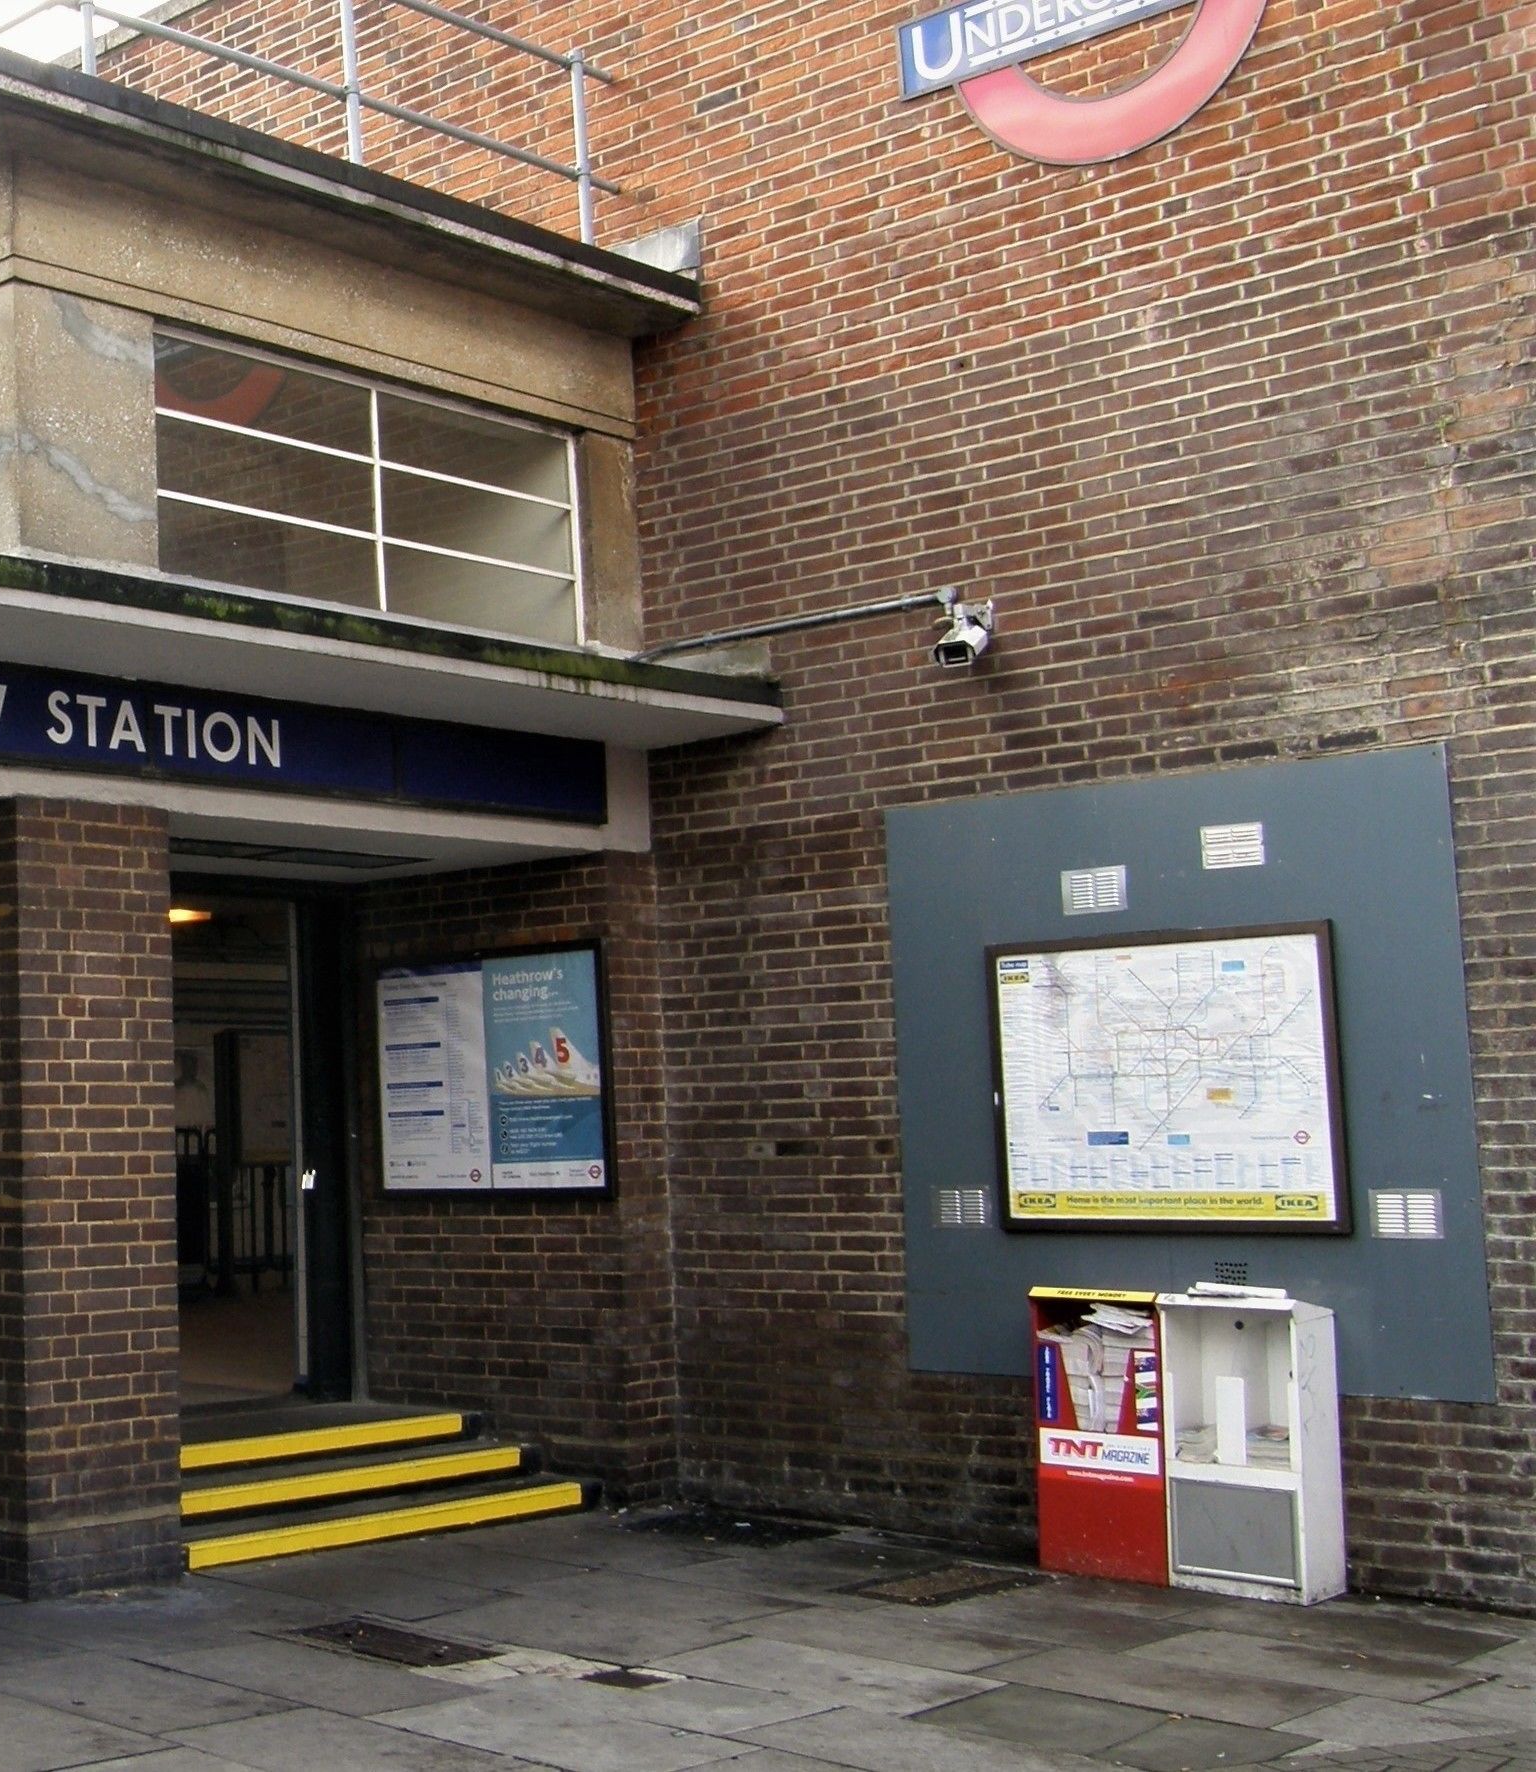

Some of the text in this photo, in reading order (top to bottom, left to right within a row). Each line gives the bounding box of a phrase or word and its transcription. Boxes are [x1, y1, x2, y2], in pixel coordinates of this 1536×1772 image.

[46, 690, 281, 768] STATION
[492, 967, 563, 986] Heathrow's
[506, 1065, 514, 1078] 2
[520, 1058, 529, 1073] 3
[535, 1046, 547, 1068] 4
[556, 1037, 570, 1064] 5
[1101, 1195, 1114, 1203] the
[1184, 1197, 1207, 1206] place
[1220, 1197, 1234, 1205] the
[1049, 1437, 1104, 1459] TNT
[1102, 1449, 1151, 1465] MAGAZINE
